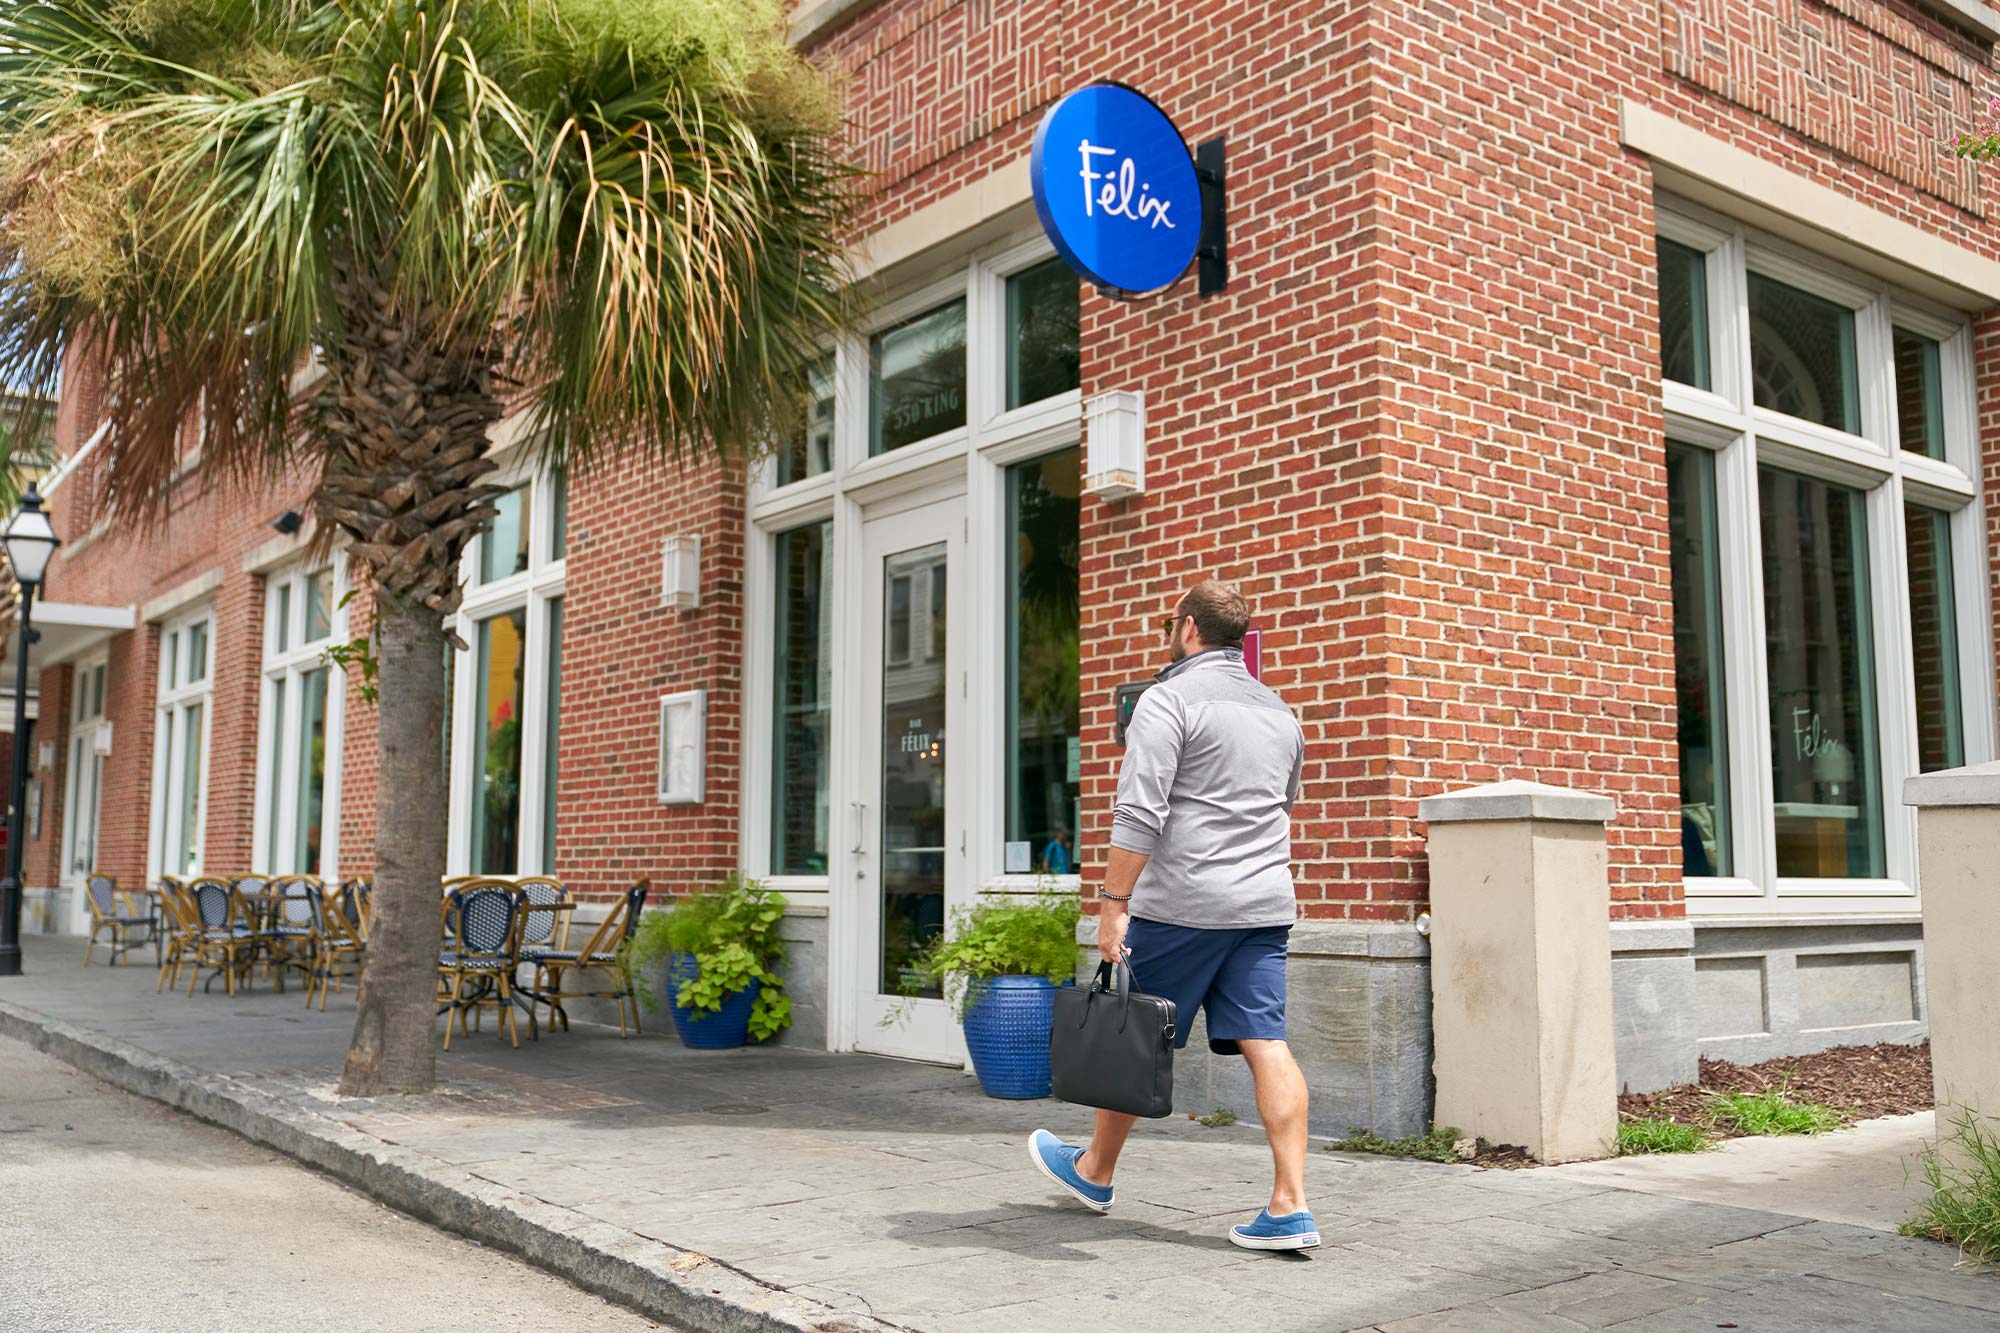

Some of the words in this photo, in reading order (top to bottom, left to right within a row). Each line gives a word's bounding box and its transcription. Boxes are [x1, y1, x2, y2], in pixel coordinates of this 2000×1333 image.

[1078, 139, 1176, 229] Félix
[924, 387, 959, 418] KING
[901, 731, 930, 752] FÉLIX
